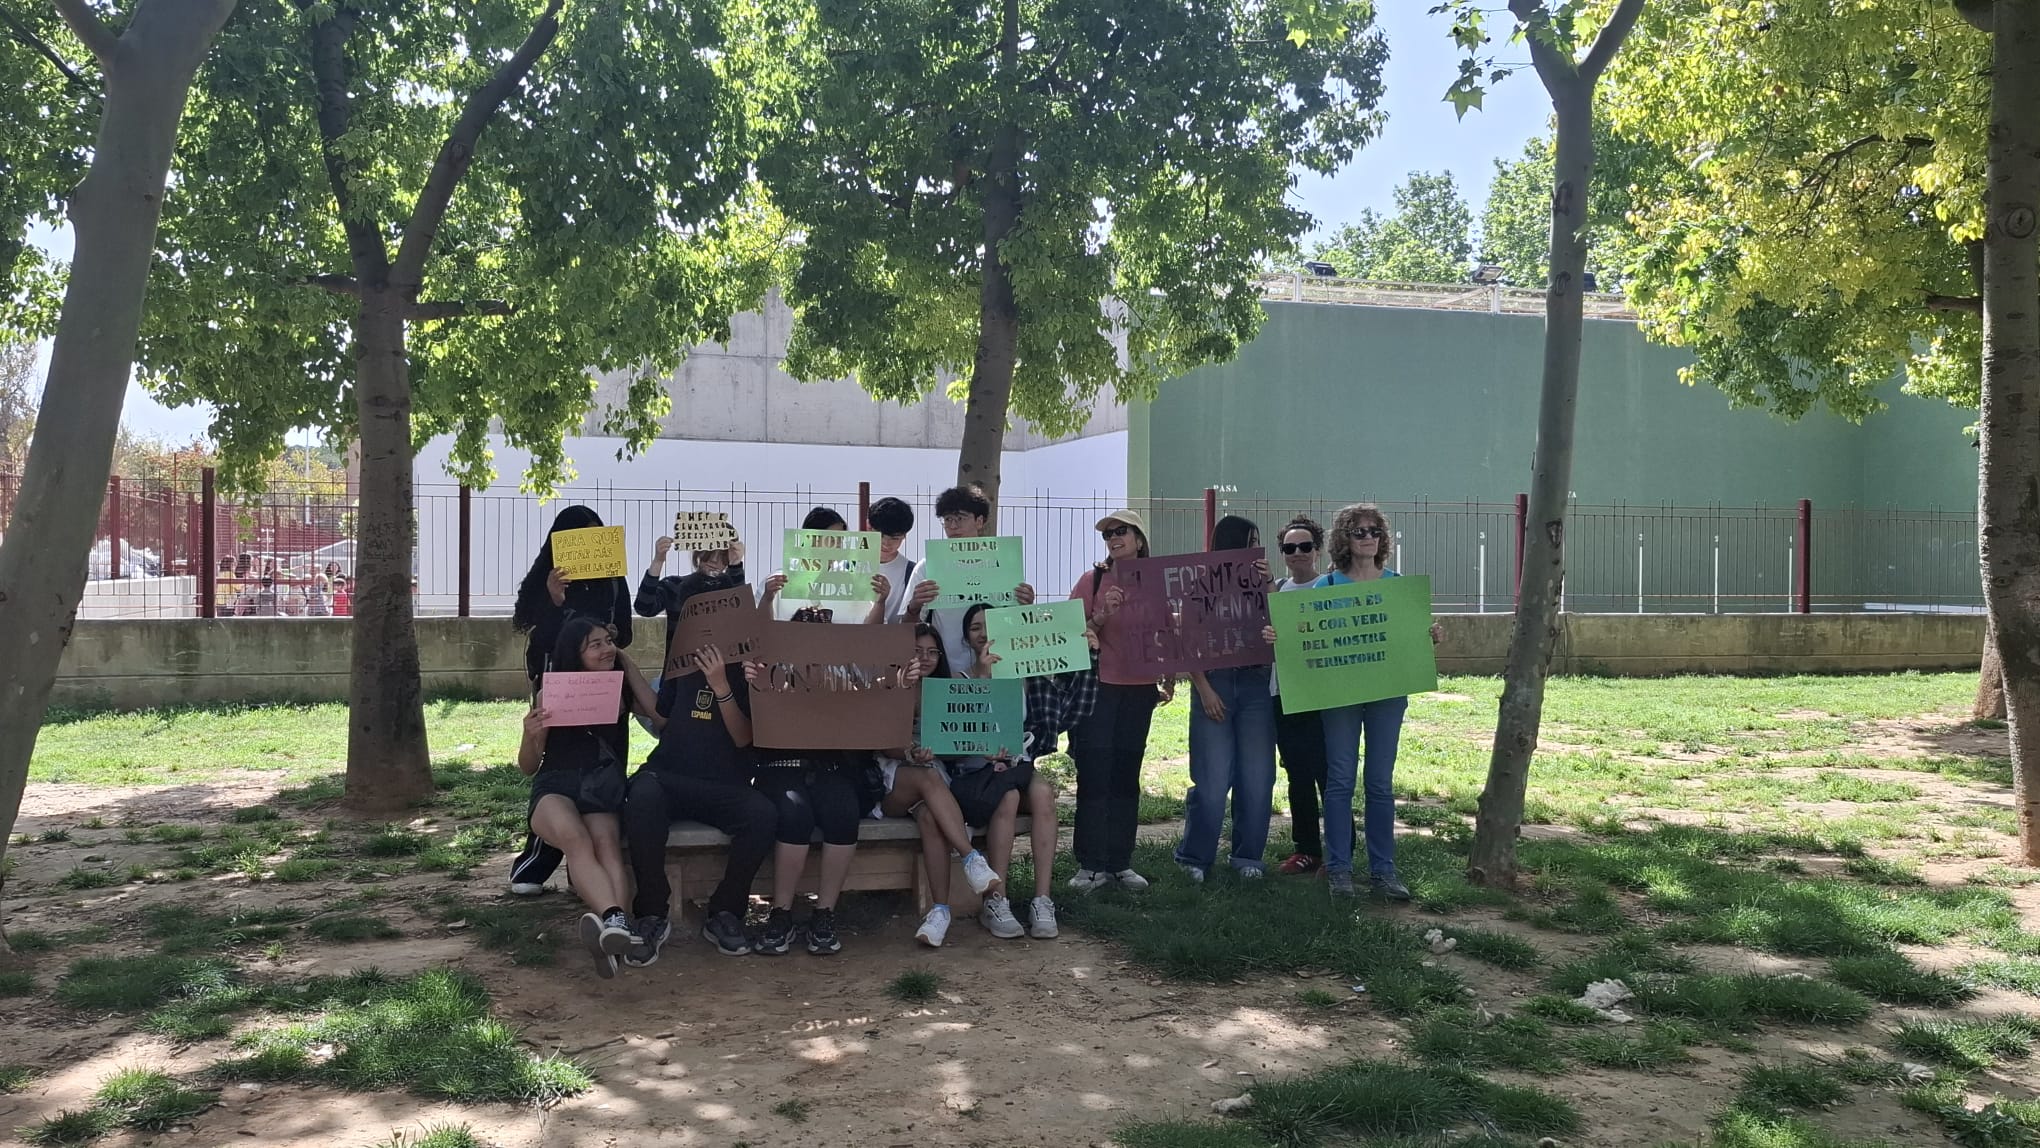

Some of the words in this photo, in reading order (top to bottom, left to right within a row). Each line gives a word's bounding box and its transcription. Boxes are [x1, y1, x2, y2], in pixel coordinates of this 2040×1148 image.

[1213, 484, 1238, 492] PASA
[555, 534, 586, 549] PARA
[794, 534, 869, 549] L'HORTA
[950, 541, 998, 552] CUIDAR
[789, 558, 822, 571] ENS
[808, 582, 853, 596] VIDA!
[1298, 621, 1315, 633] EL
[1318, 618, 1348, 631] COR
[1351, 613, 1388, 627] VERD
[1010, 632, 1068, 651] ESPAIS
[1302, 640, 1329, 651] DEL
[1333, 632, 1388, 648] NOSTRE
[1014, 656, 1069, 675] VERDS
[1306, 651, 1386, 669] TERRITORI!
[948, 683, 992, 695] SENSE
[947, 702, 993, 714] HORTA
[940, 721, 959, 733] NO
[963, 721, 977, 733] HI
[953, 740, 990, 752] VIDA!
